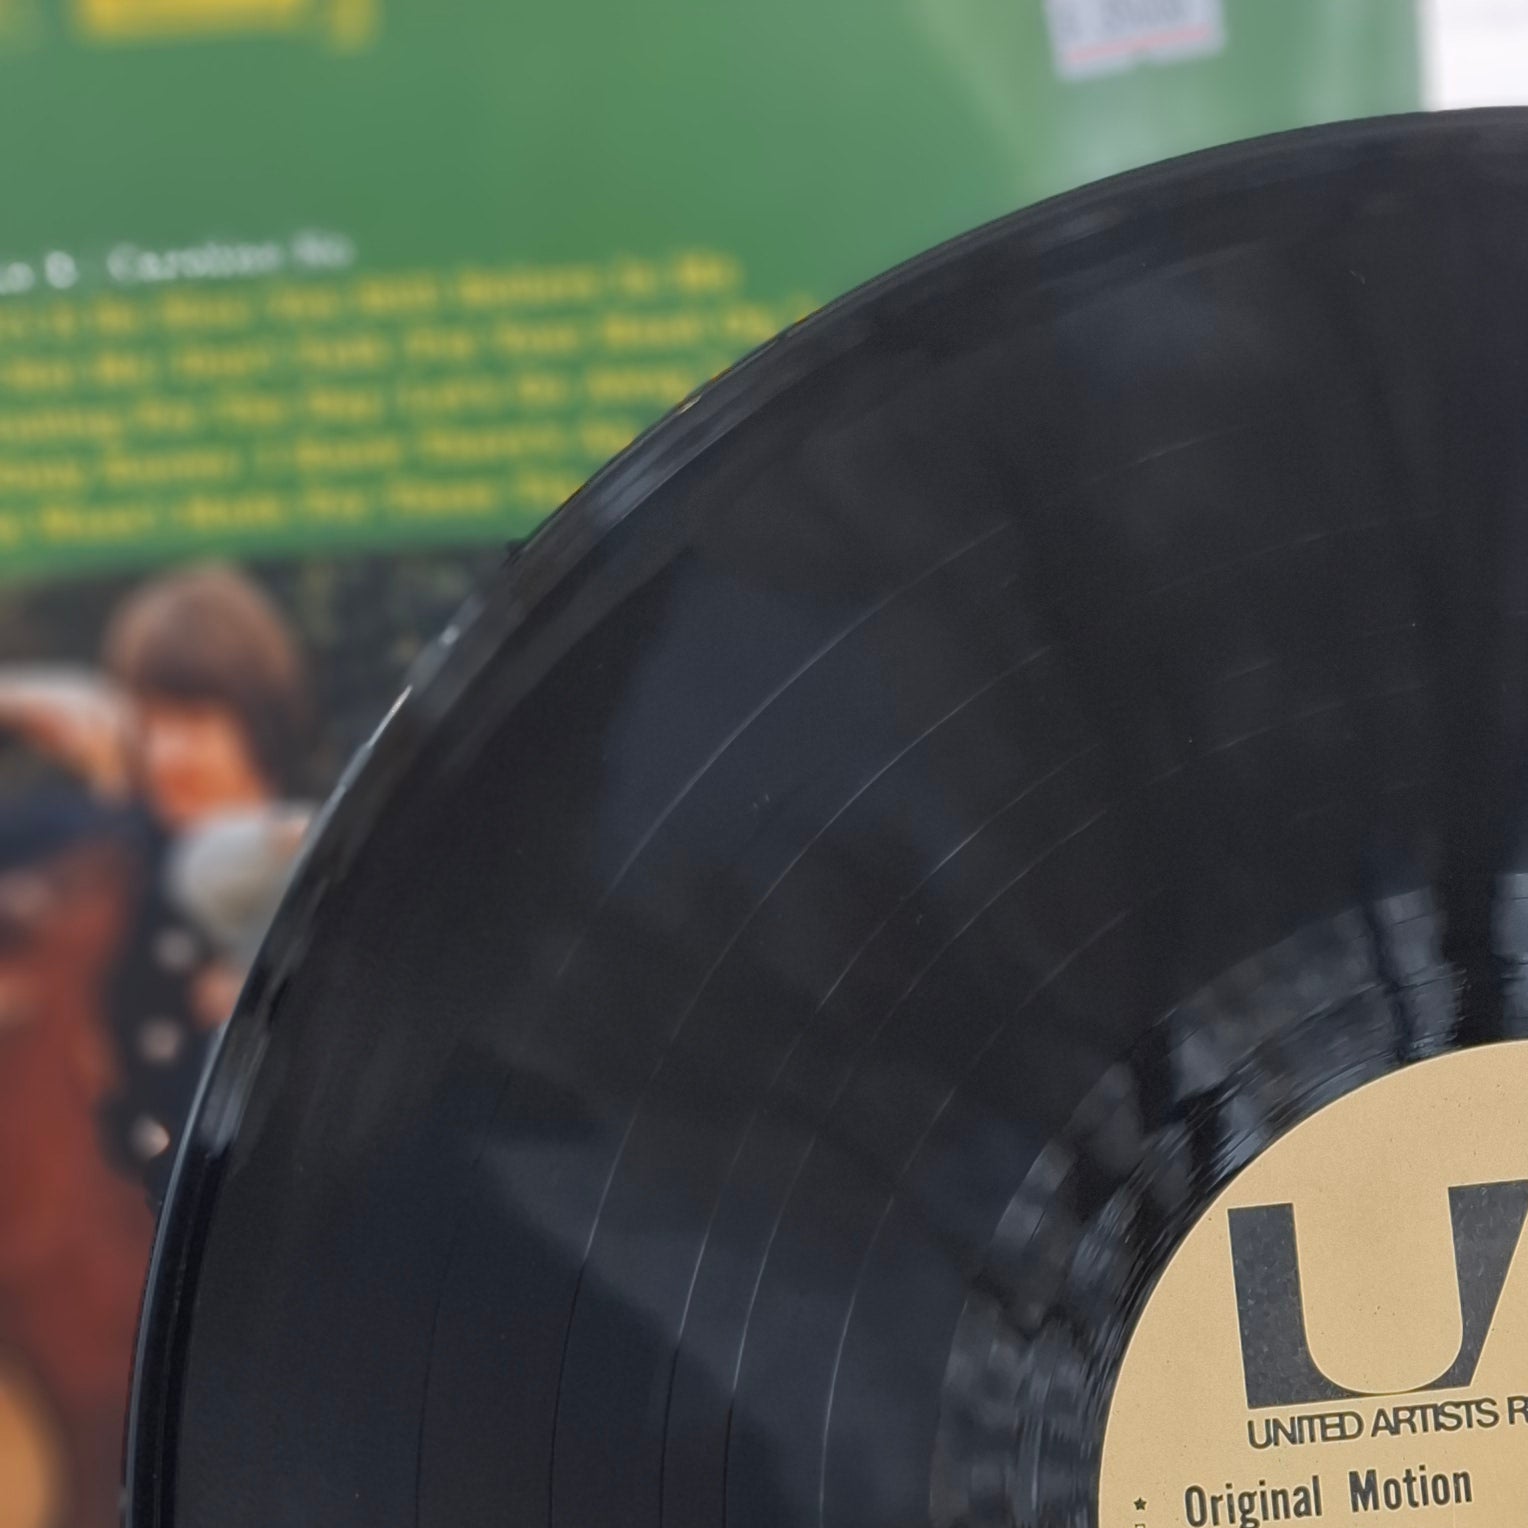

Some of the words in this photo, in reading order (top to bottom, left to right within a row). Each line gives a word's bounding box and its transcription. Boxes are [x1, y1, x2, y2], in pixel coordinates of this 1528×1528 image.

[1247, 1410, 1363, 1449] UNITED
[1371, 1398, 1499, 1437] ARTISTS
[1349, 1464, 1473, 1513] Motion
